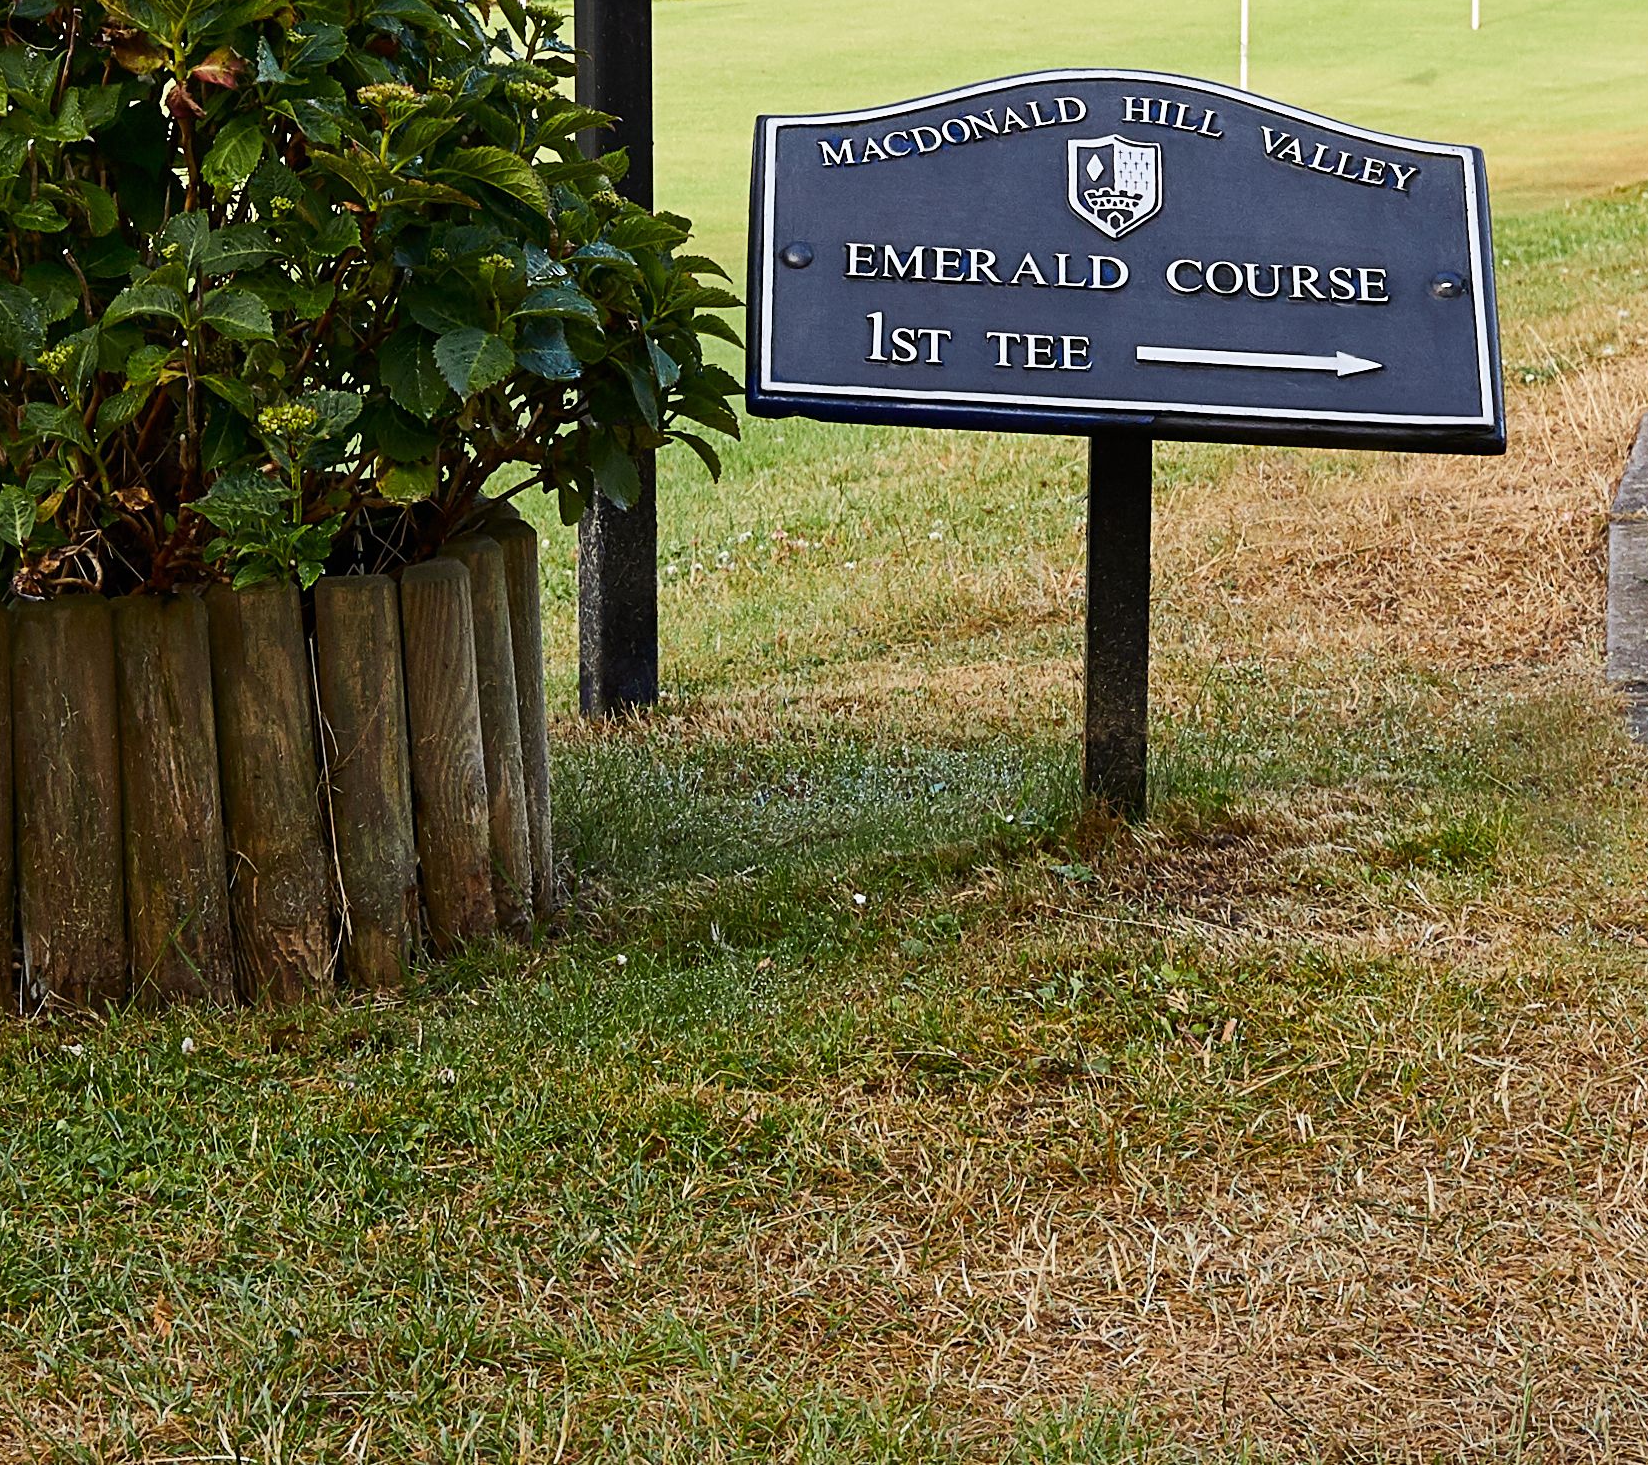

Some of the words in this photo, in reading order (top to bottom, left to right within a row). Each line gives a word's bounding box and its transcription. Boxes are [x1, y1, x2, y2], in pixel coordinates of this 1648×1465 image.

[818, 97, 1086, 165] MACDONALD
[1122, 97, 1222, 137] HILL
[1261, 126, 1416, 190] VALLEY
[846, 243, 1128, 288] EMERALD
[1167, 260, 1388, 301] COURSE
[867, 312, 951, 362] 1ST
[987, 332, 1092, 369] TEE
